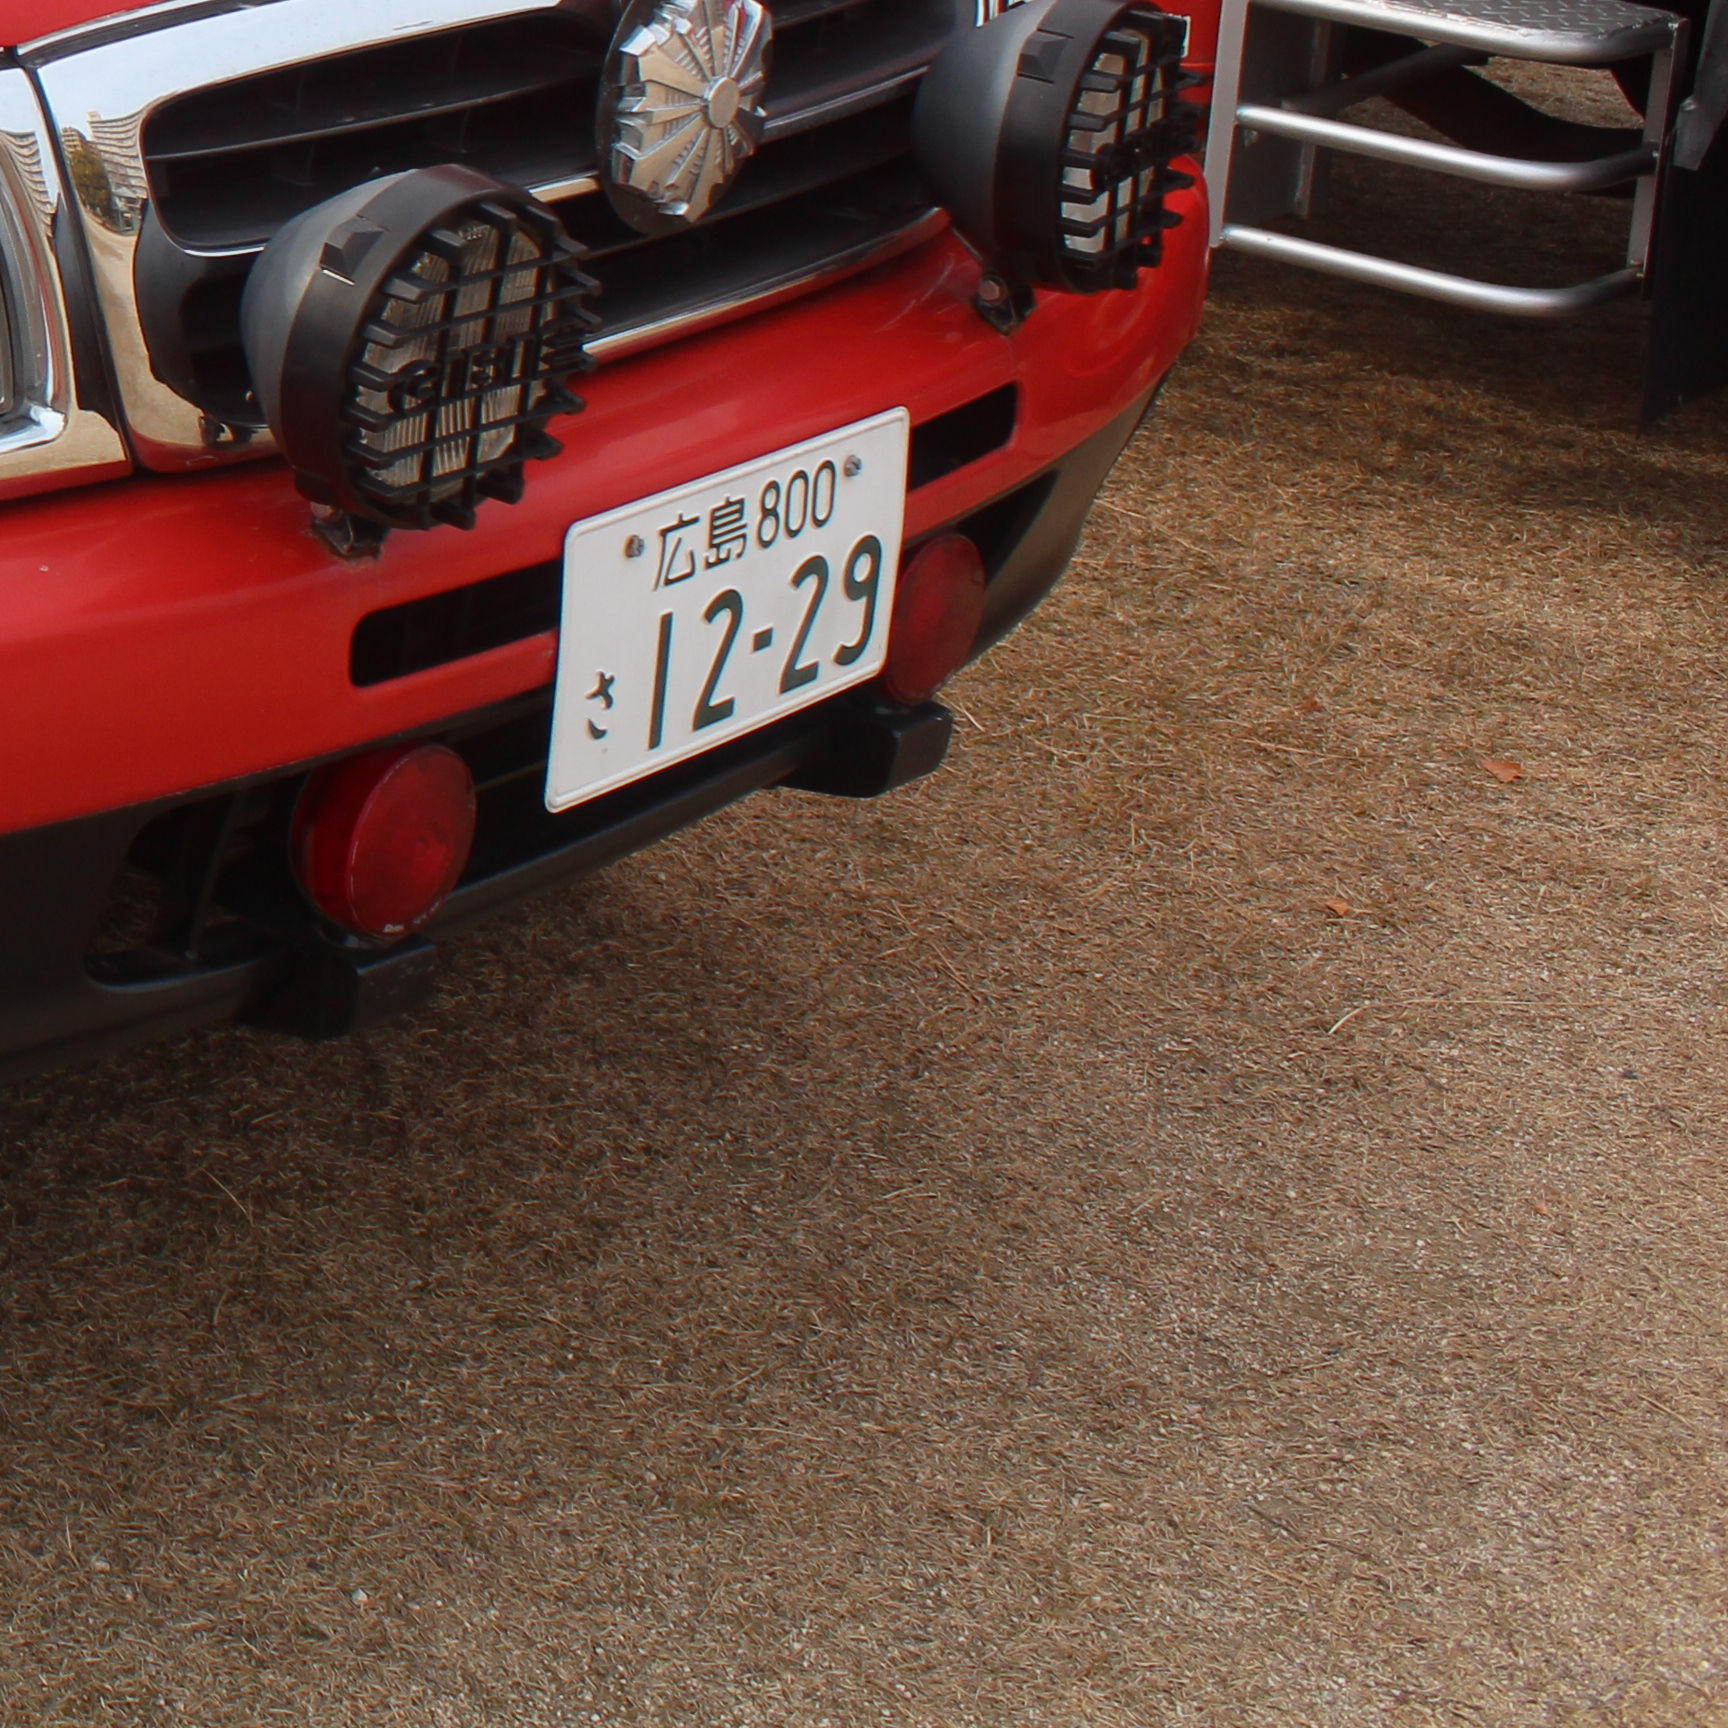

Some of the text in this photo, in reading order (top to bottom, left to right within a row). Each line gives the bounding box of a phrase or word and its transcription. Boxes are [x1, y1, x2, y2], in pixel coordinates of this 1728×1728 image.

[652, 458, 837, 590] 広島 800
[585, 533, 884, 750] さ 12-29
